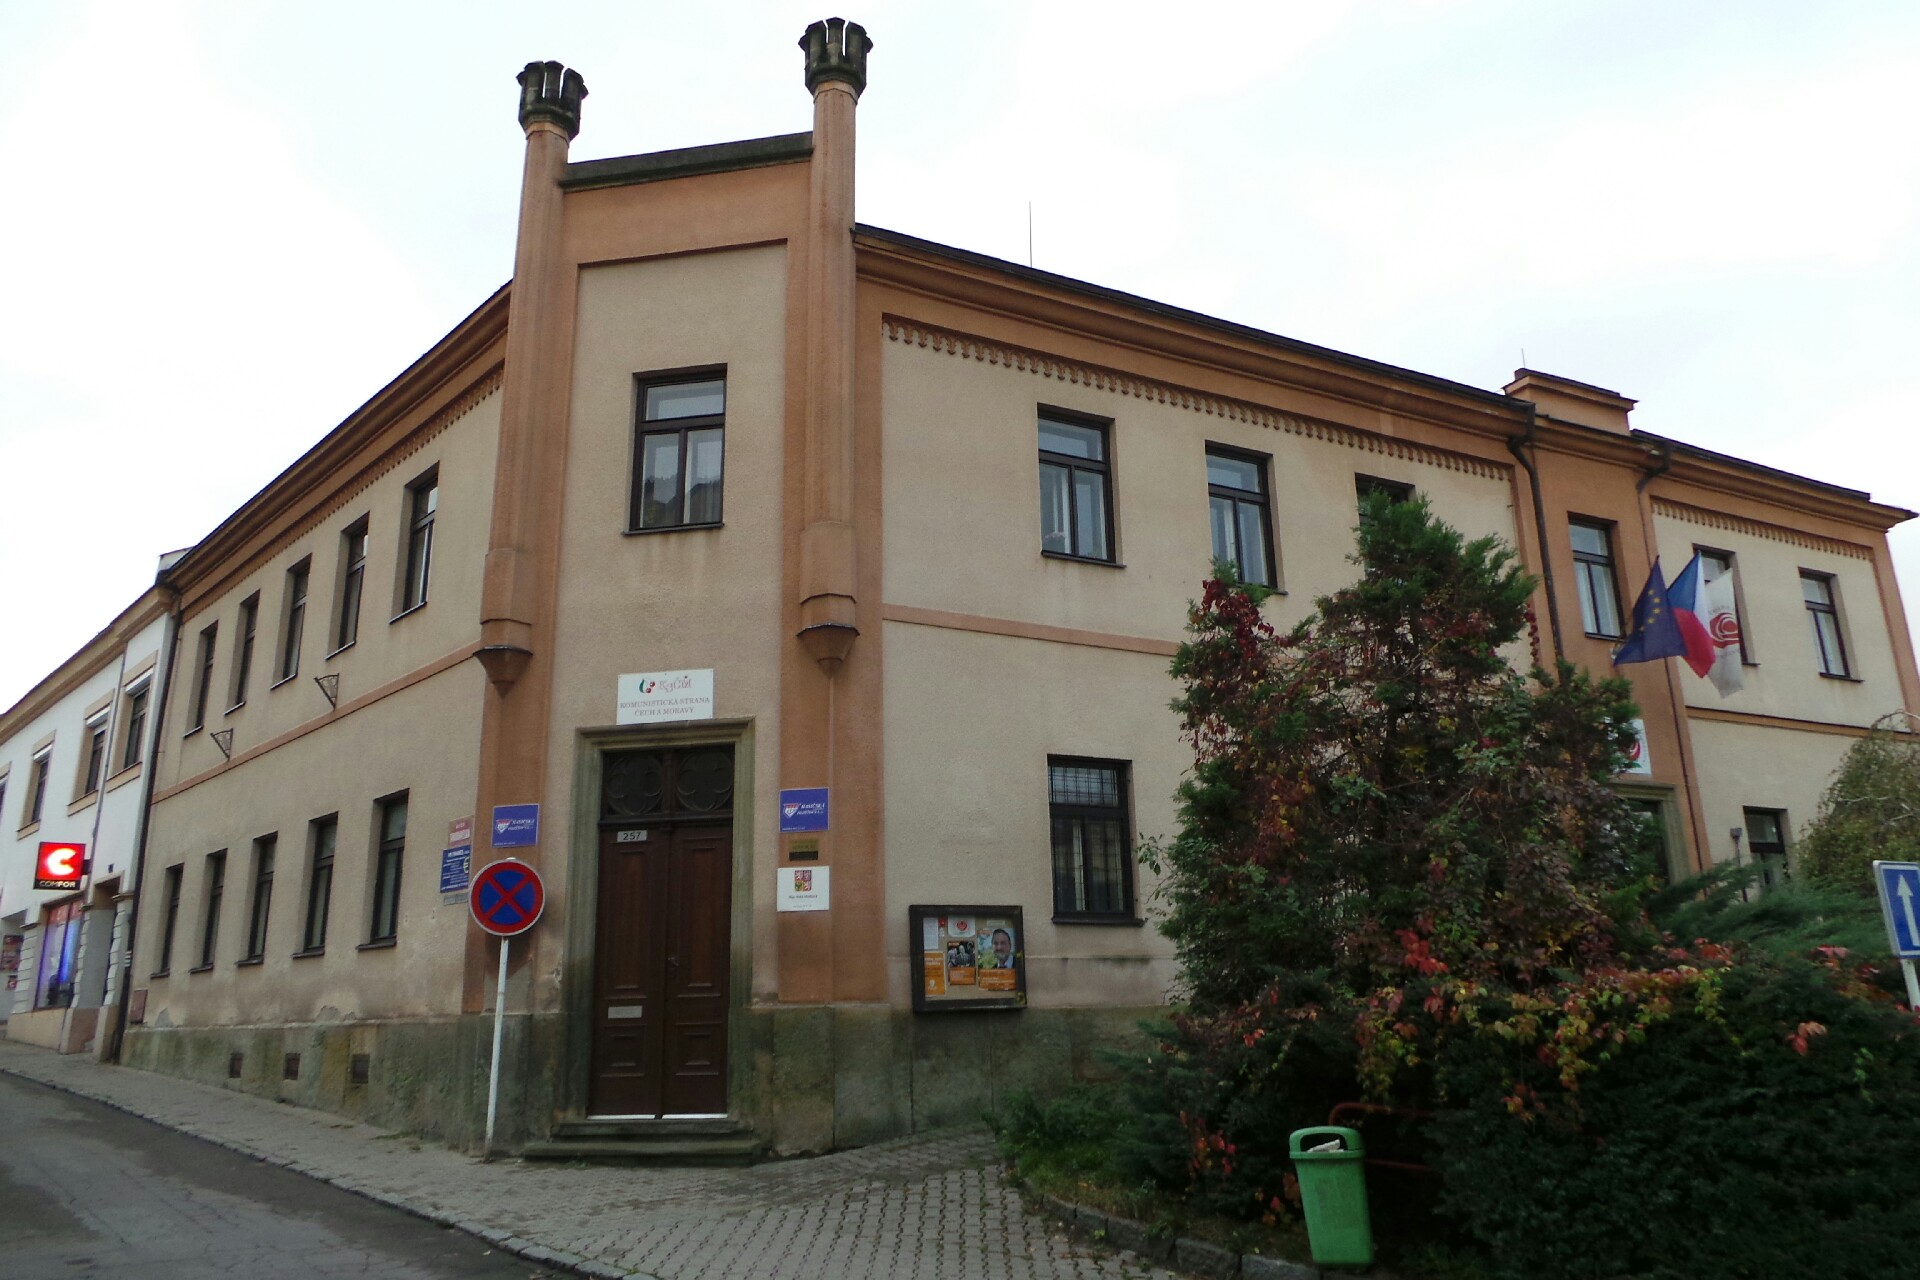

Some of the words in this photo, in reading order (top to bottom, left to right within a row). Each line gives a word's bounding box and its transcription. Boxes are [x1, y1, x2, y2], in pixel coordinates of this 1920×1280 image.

[679, 697, 710, 706] STRANA
[662, 706, 694, 715] MORAVY
[623, 832, 641, 841] 257
[39, 880, 76, 888] COMFOR
